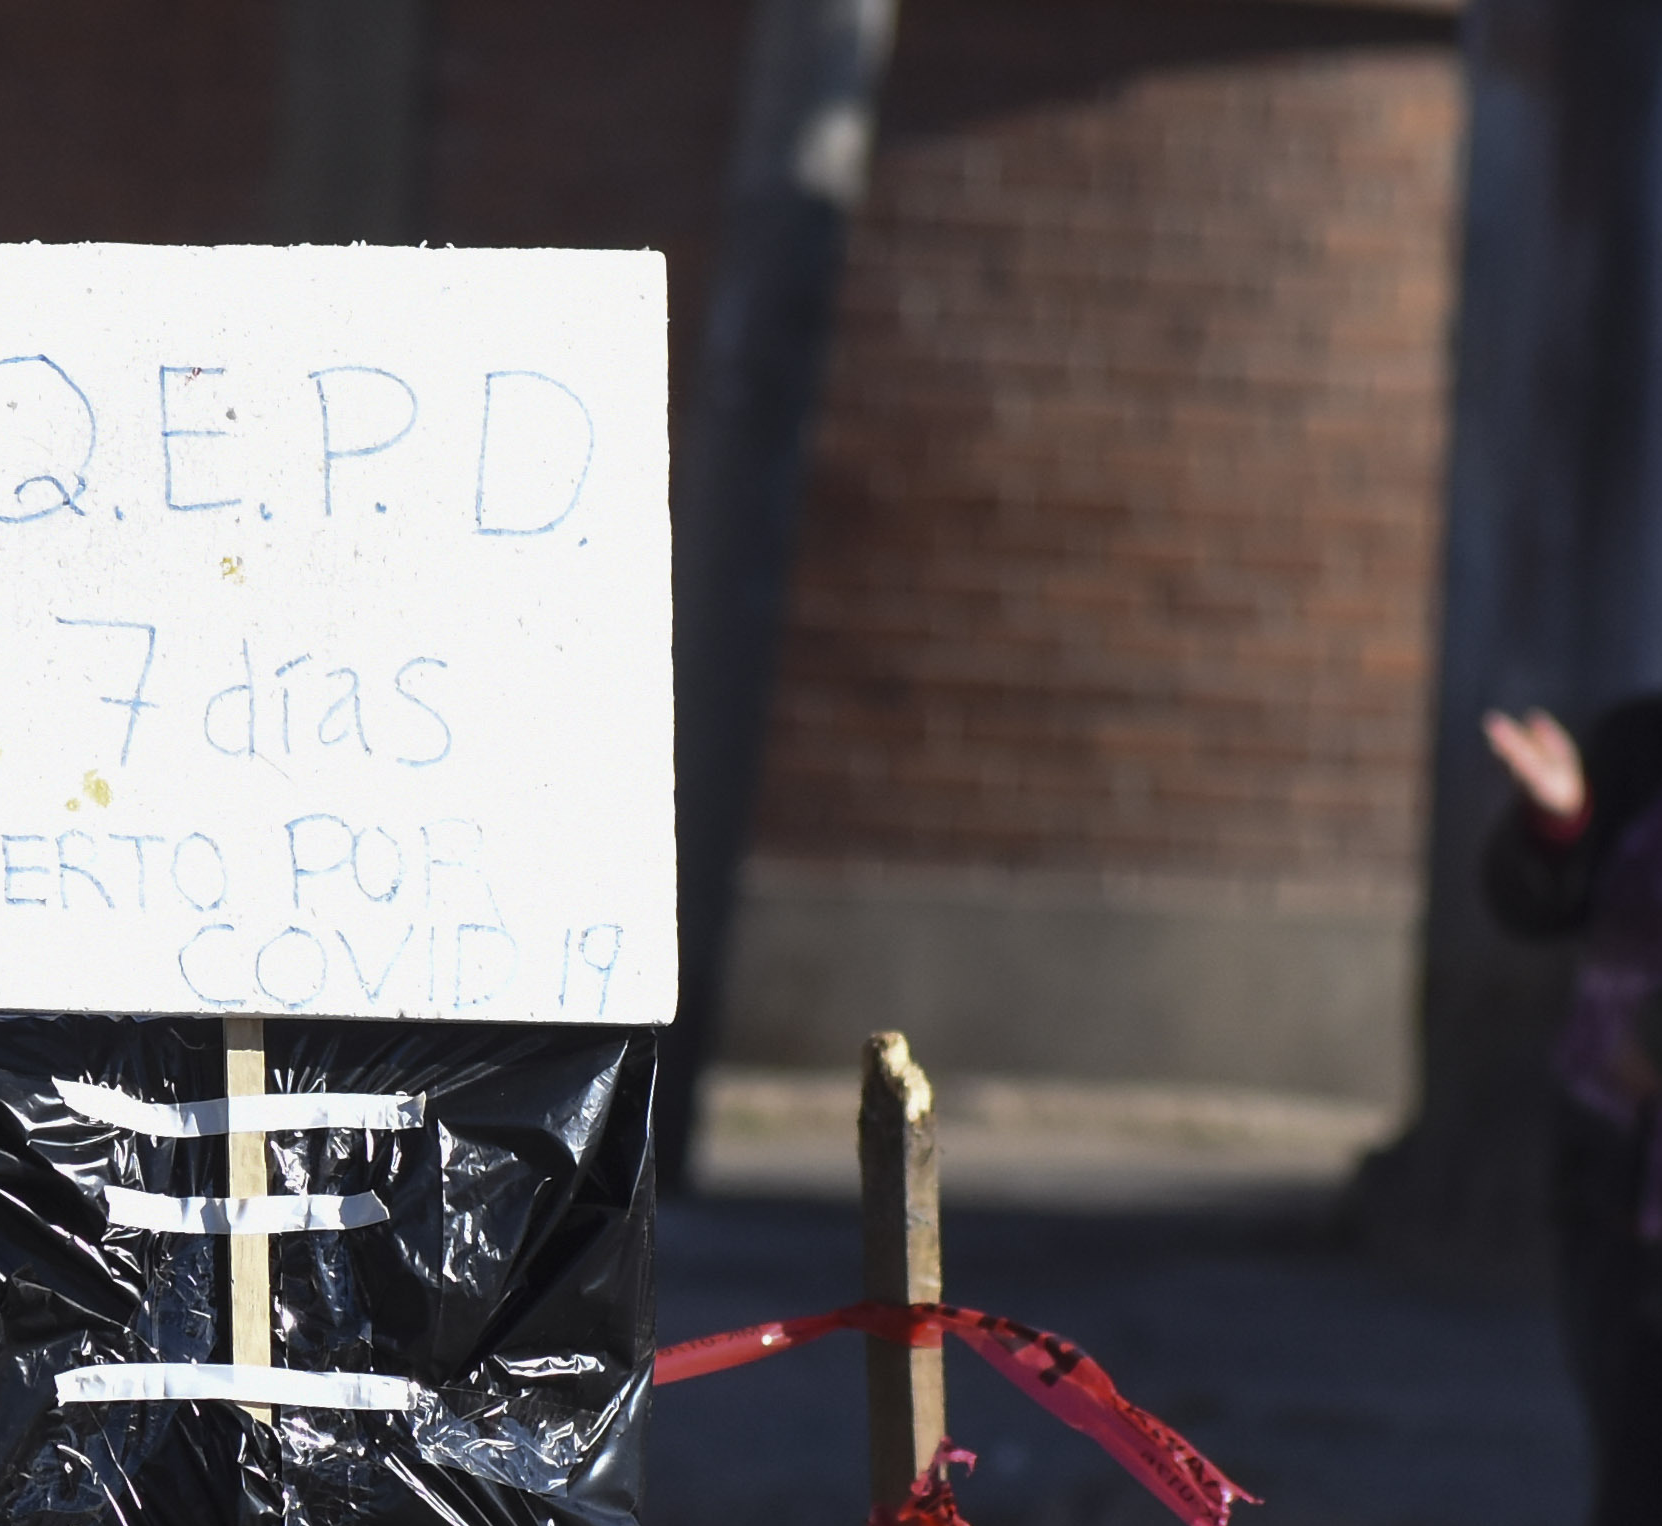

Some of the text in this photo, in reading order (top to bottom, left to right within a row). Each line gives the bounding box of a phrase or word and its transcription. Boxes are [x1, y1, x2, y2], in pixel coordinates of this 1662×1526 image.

[55, 616, 453, 767] 7 días
[284, 813, 508, 927] POR
[178, 922, 624, 1017] COVID 19
